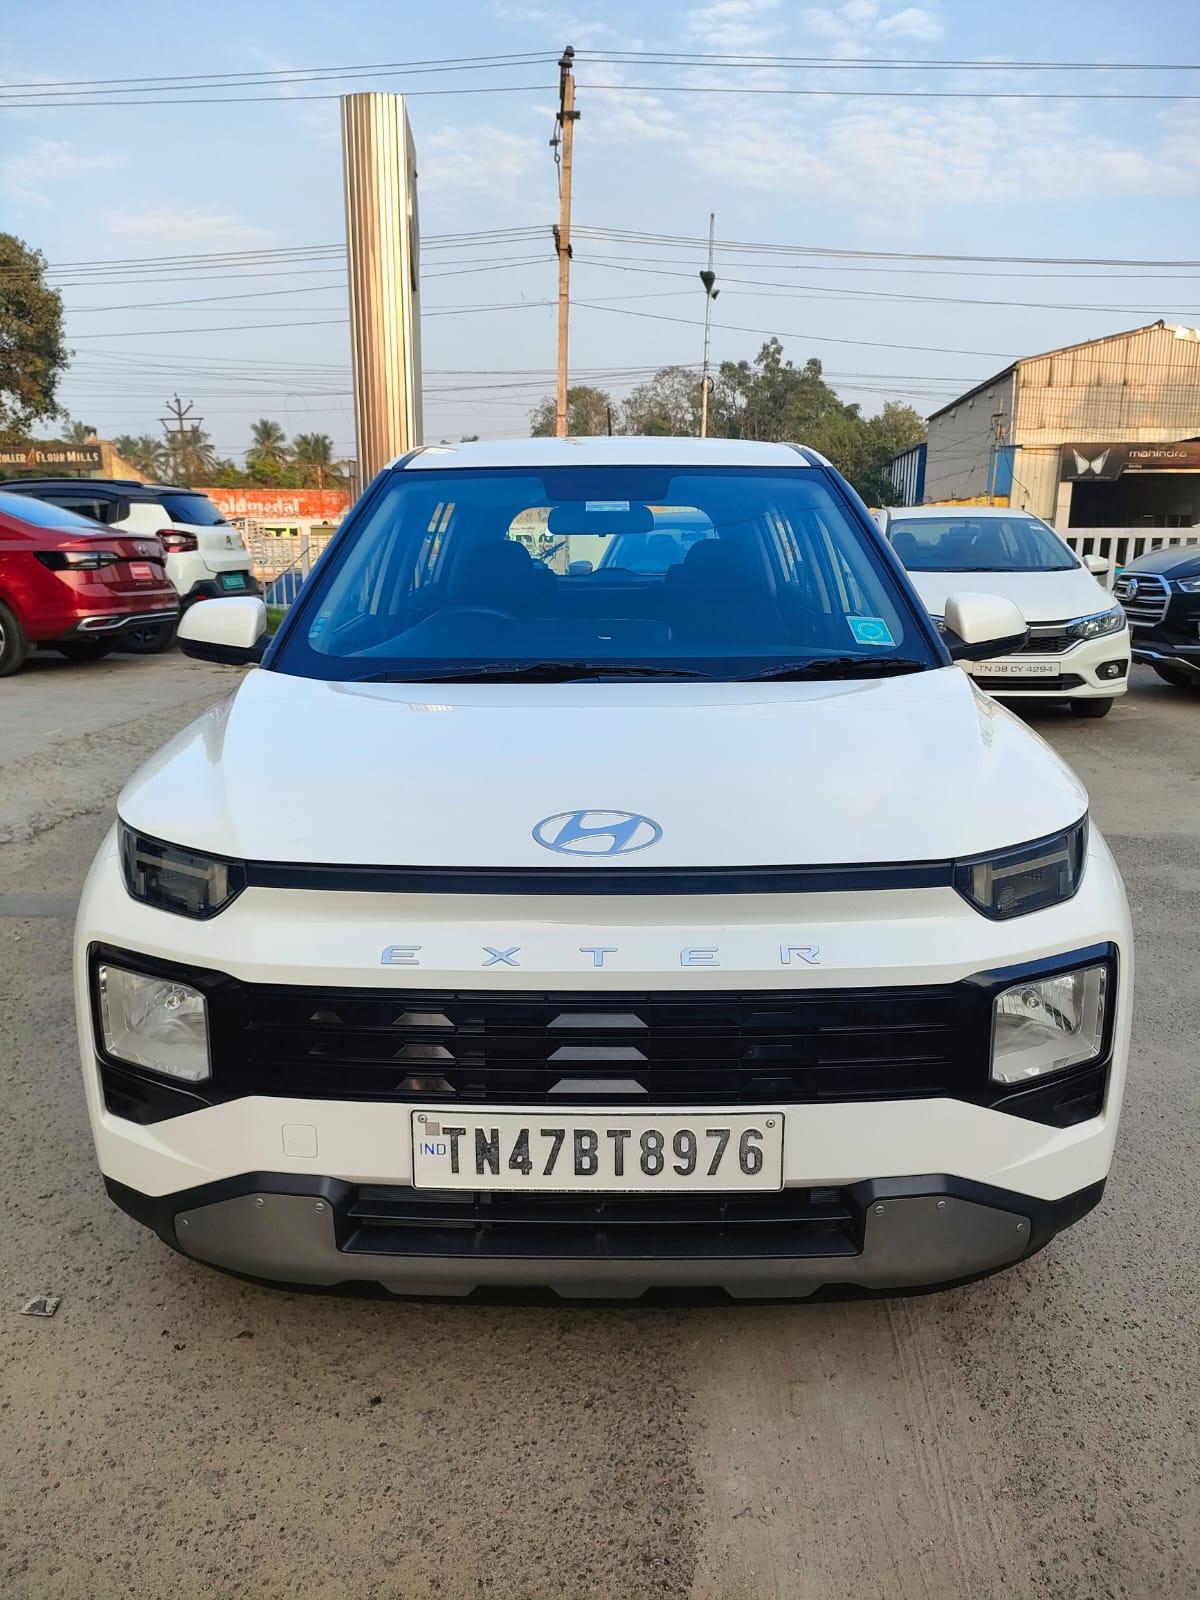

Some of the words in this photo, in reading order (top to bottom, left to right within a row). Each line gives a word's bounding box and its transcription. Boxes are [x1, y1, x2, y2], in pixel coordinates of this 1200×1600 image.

[35, 451, 65, 463] FLOUR
[66, 451, 99, 462] MILLS
[1128, 449, 1188, 458] mahindra
[978, 665, 992, 673] TN
[994, 665, 1008, 673] 38
[1010, 665, 1024, 673] CY
[1026, 665, 1053, 673] 4294
[380, 944, 821, 967] EXTER
[419, 1142, 447, 1157] IND
[442, 1127, 764, 1177] TN47BT8976
